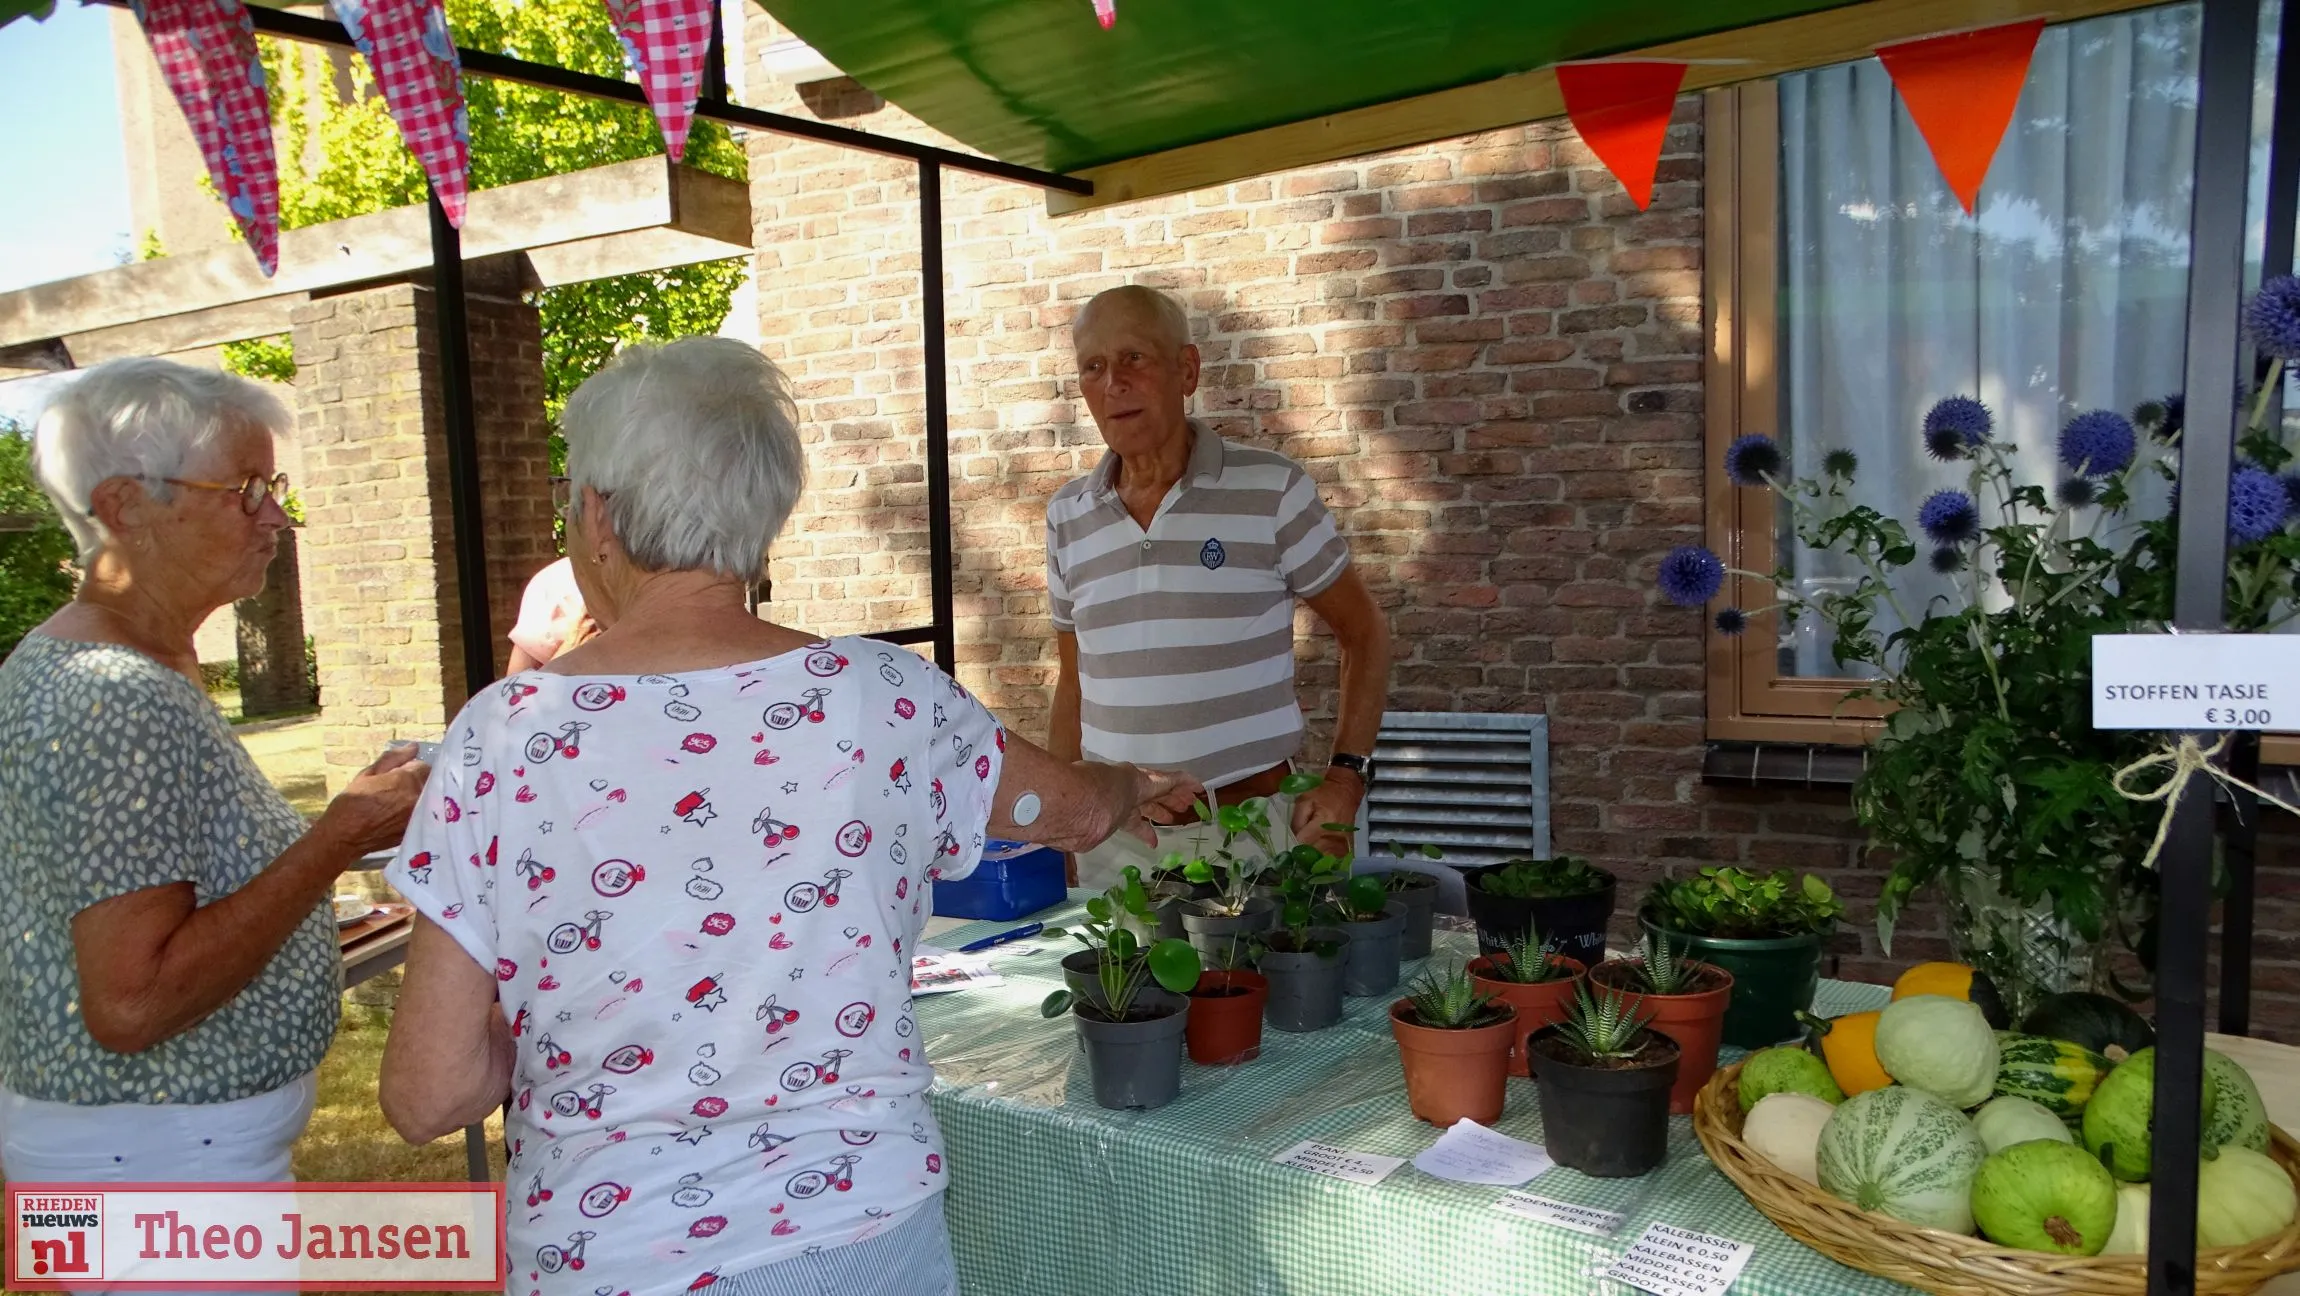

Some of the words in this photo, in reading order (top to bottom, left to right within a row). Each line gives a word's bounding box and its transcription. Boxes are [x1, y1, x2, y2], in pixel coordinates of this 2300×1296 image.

[2105, 685, 2198, 700] STOFFEN
[2205, 684, 2269, 700] TASJE
[2205, 708, 2217, 723] €
[2224, 708, 2271, 726] 3,00
[1303, 1150, 1344, 1161] GROOT
[1311, 1144, 1348, 1155] PLANT
[1284, 1160, 1317, 1171] KLEIN
[1294, 1155, 1336, 1168] MIDDEL
[1351, 1166, 1374, 1175] 2,50
[1551, 1213, 1577, 1223] PER
[1652, 1223, 1741, 1252] KALEBASSEN
[1643, 1234, 1684, 1250] KLEIN
[1686, 1245, 1697, 1253] €
[1698, 1248, 1729, 1262] 0,50
[1632, 1244, 1722, 1273] KALEBASSEN
[1608, 1269, 1661, 1289] GROOT
[1616, 1261, 1707, 1293] KALEBASSEN
[1624, 1253, 1678, 1274] MIDDEL
[1695, 1273, 1727, 1287] 0,75
